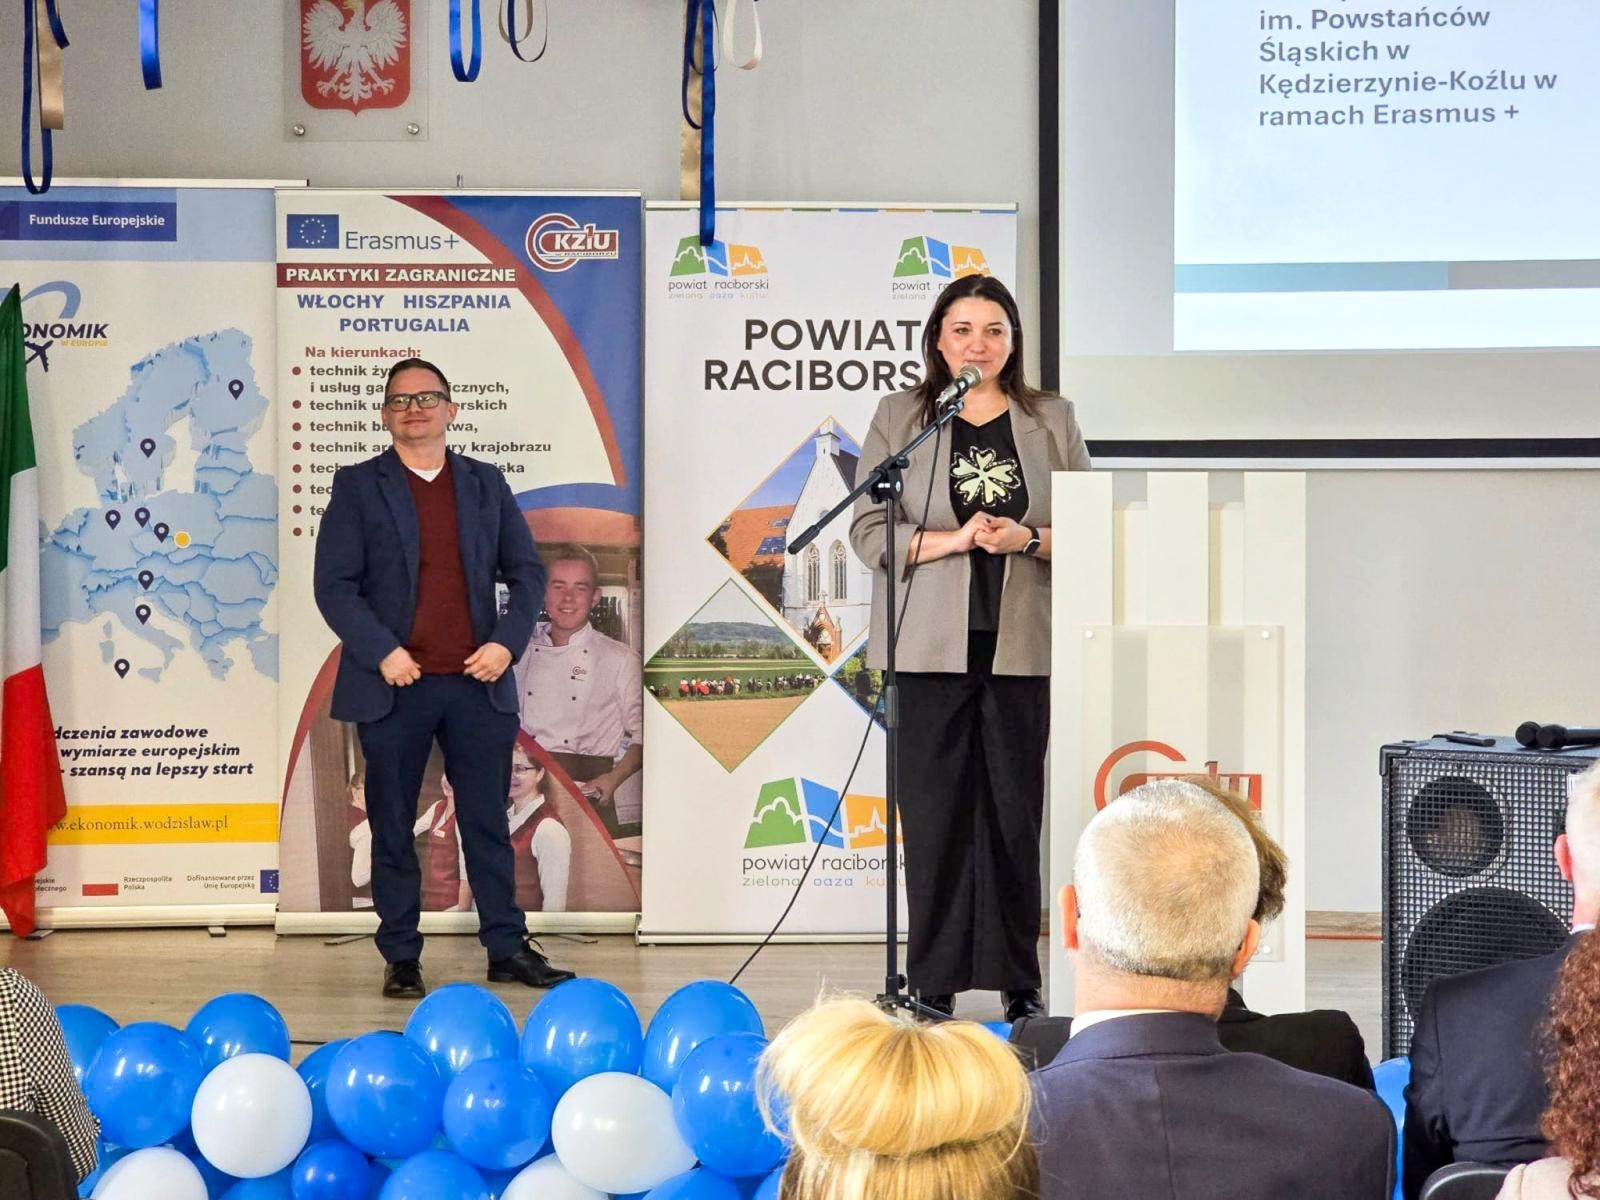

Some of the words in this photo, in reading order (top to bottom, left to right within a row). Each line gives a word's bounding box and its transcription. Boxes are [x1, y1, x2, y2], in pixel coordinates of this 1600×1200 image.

[1260, 10, 1302, 30] im.
[1311, 6, 1491, 29] Powstańców
[1259, 36, 1379, 67] Śląskich
[1387, 43, 1411, 60] w
[1260, 70, 1526, 98] Kędzierzynie-Koźlu
[1534, 74, 1558, 89] w
[1259, 105, 1364, 126] ramach
[1374, 104, 1497, 125] Erasmus
[29, 214, 89, 226] Fundusze
[92, 214, 165, 228] Europejskie
[345, 231, 460, 251] Erasmus+
[285, 268, 380, 282] PRAKTYKI
[385, 268, 516, 283] ZAGRANICZNE
[668, 279, 708, 292] powiat
[714, 278, 769, 290] raciborski
[892, 280, 931, 293] powiat
[297, 292, 384, 309] WŁOCHY
[404, 294, 511, 309] HISZPANIA
[23, 323, 109, 339] ONOMIK
[339, 318, 470, 332] PORTUGALIA
[744, 319, 922, 351] POWIAT
[305, 346, 326, 358] Na
[331, 346, 422, 358] kierunkach:
[309, 365, 367, 376] technik
[704, 359, 922, 392] RACIBORS
[310, 381, 315, 392] i
[320, 381, 360, 395] usług
[309, 400, 367, 411] technik
[309, 421, 367, 432] technik
[309, 441, 367, 453] technik
[471, 441, 551, 455] krajobrazu
[120, 725, 209, 739] zawodowe
[60, 744, 137, 762] wymiarze
[141, 742, 241, 760] europejskim
[70, 766, 127, 781] szansą
[130, 766, 151, 777] na
[156, 762, 209, 780] lepszy
[212, 762, 254, 776] start
[742, 853, 809, 875] powiat
[813, 876, 854, 887] oaza
